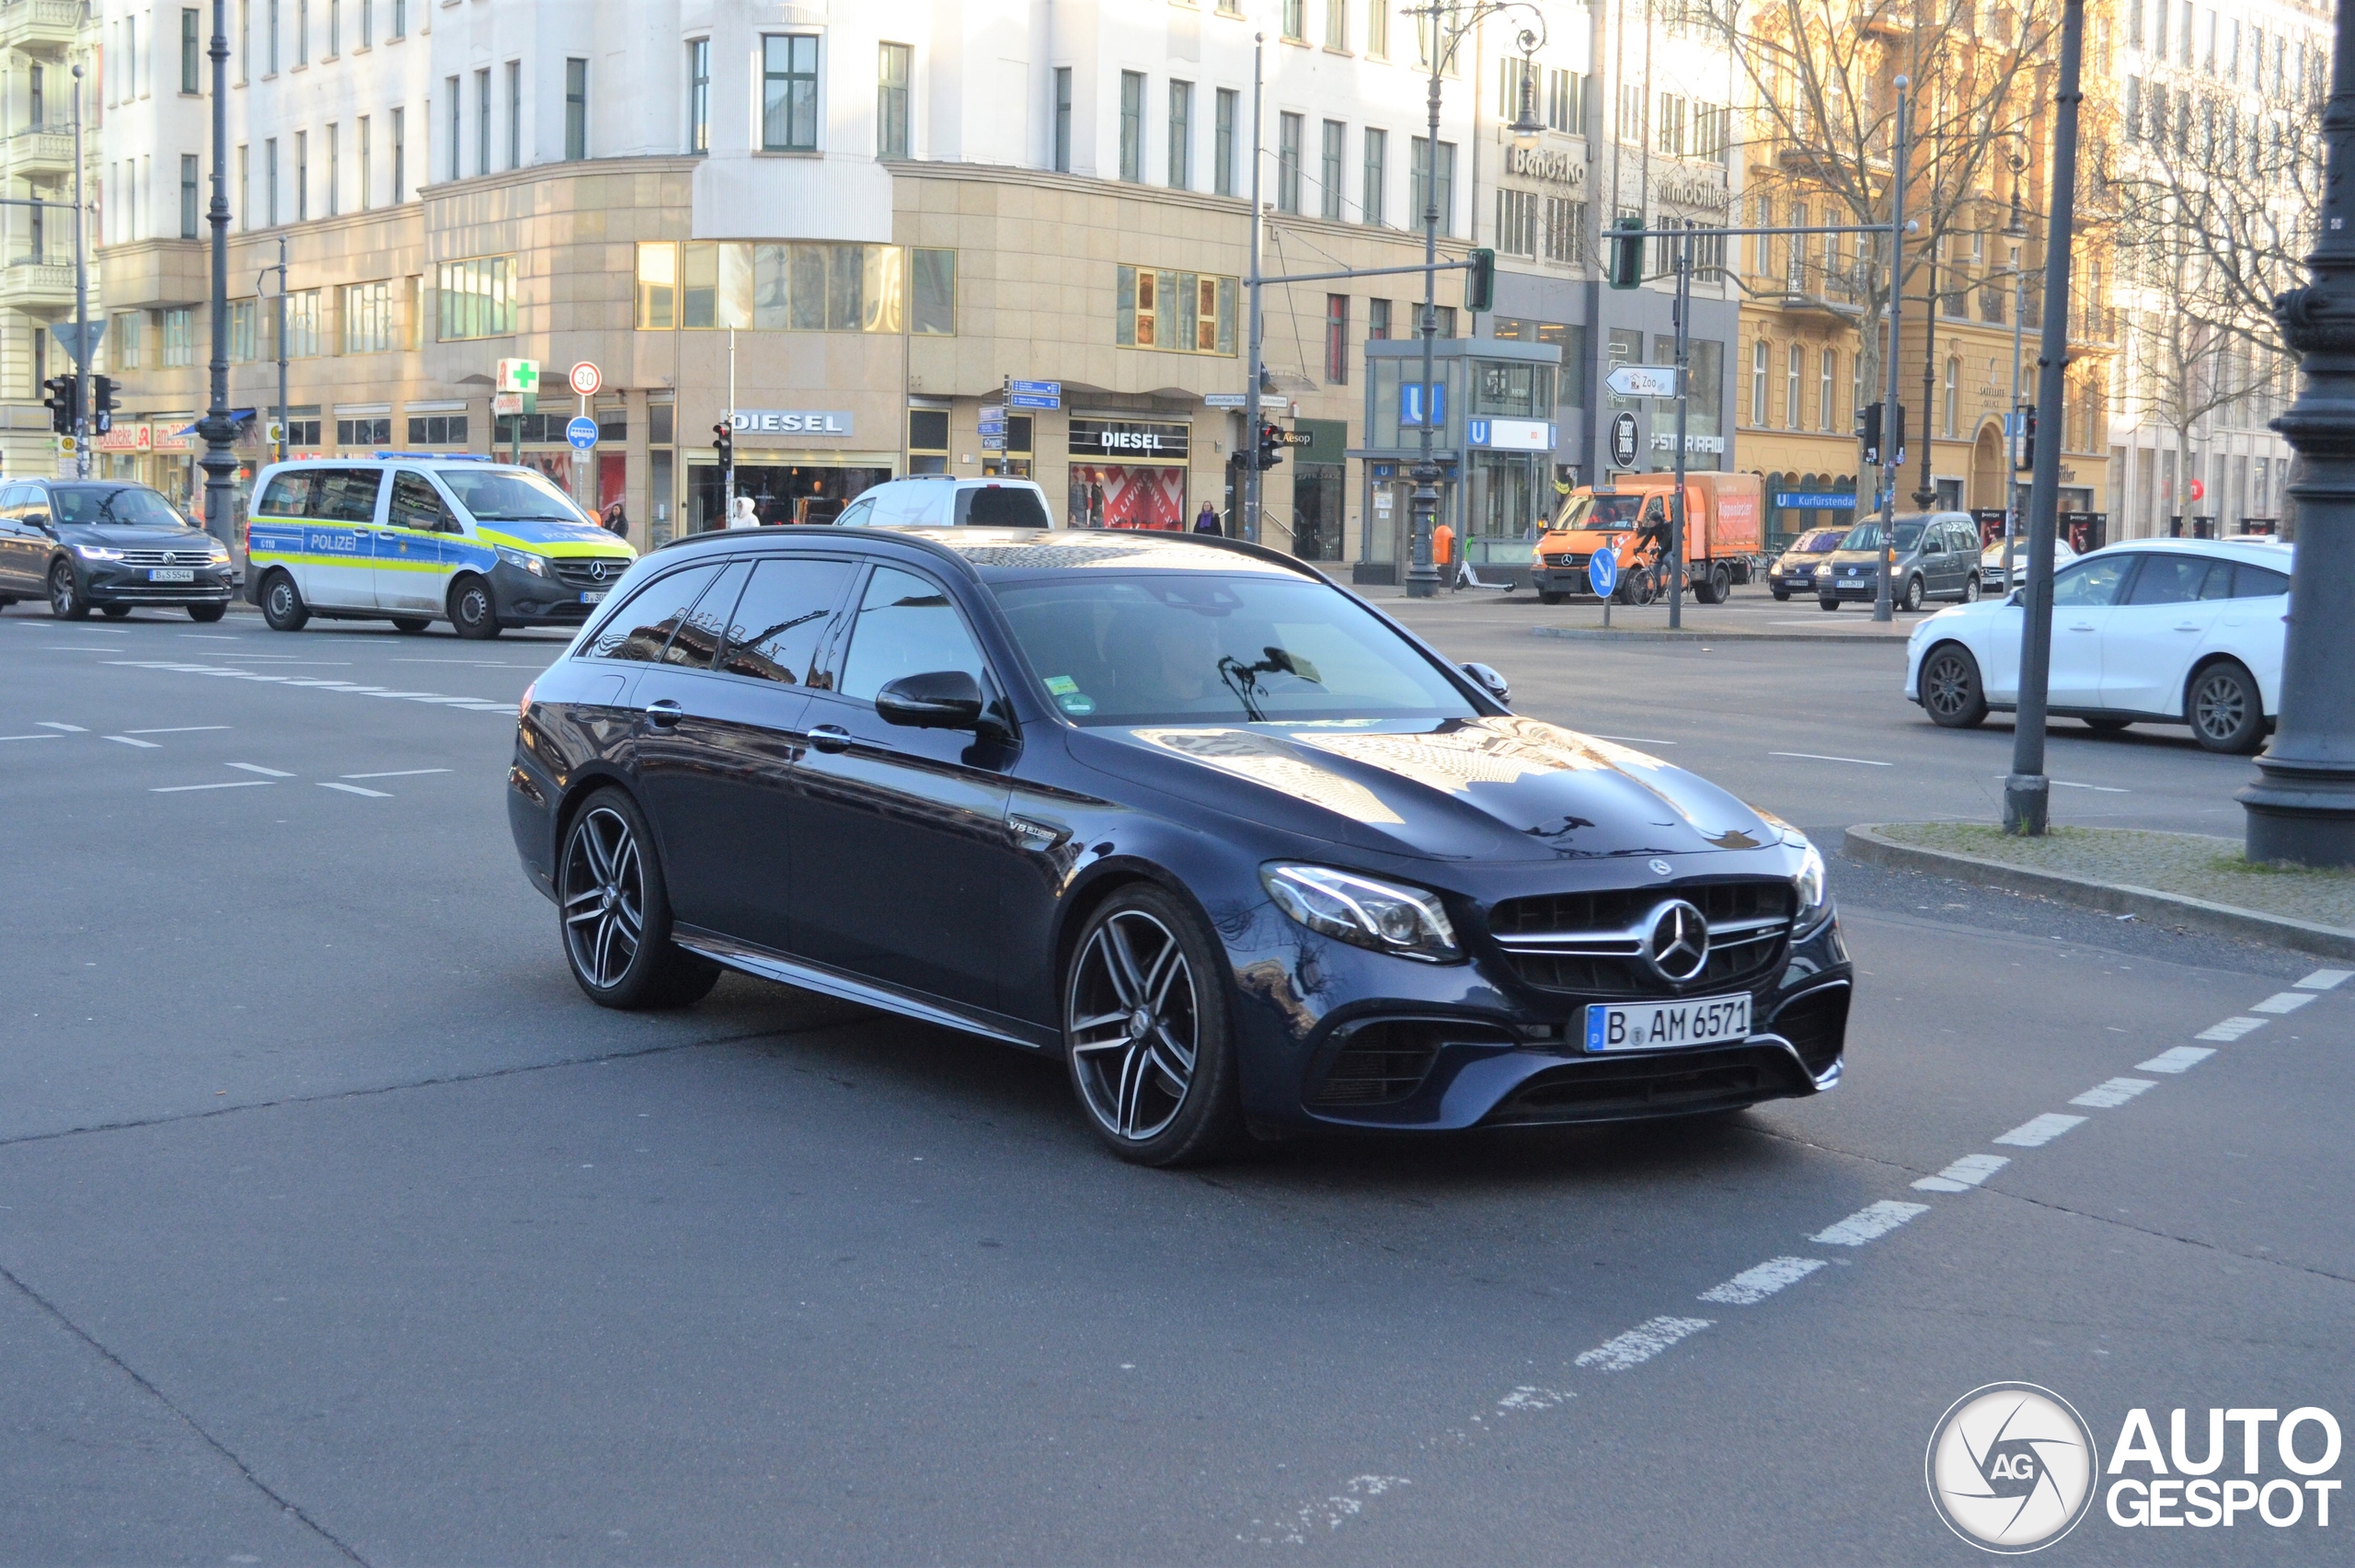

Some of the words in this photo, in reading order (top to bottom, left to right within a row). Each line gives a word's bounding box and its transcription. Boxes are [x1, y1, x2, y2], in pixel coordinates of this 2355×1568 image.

[577, 372, 594, 386] 30
[1642, 375, 1657, 388] Zoo
[732, 414, 844, 432] DIESEL
[1619, 420, 1634, 437] ZIGGY
[156, 429, 168, 445] am
[1283, 434, 1310, 444] Aesop
[1472, 421, 1486, 443] U
[1550, 425, 1557, 448] U
[1101, 431, 1163, 450] DIESEL
[1696, 435, 1725, 453] RAW
[1381, 465, 1388, 475] U
[1776, 494, 1786, 507] U
[1798, 496, 1855, 506] Kurfürstenda
[265, 539, 276, 548] 110
[311, 534, 357, 551] POLIZEI
[156, 571, 162, 579] B
[166, 571, 171, 579] S
[172, 571, 190, 579] 5544
[584, 593, 590, 601] B
[1009, 821, 1028, 832] V8
[1026, 826, 1058, 839] BITURBO
[1591, 1033, 1600, 1044] D
[1607, 1011, 1626, 1045] B
[1649, 1008, 1686, 1043] AM
[1693, 1001, 1747, 1039] 6571
